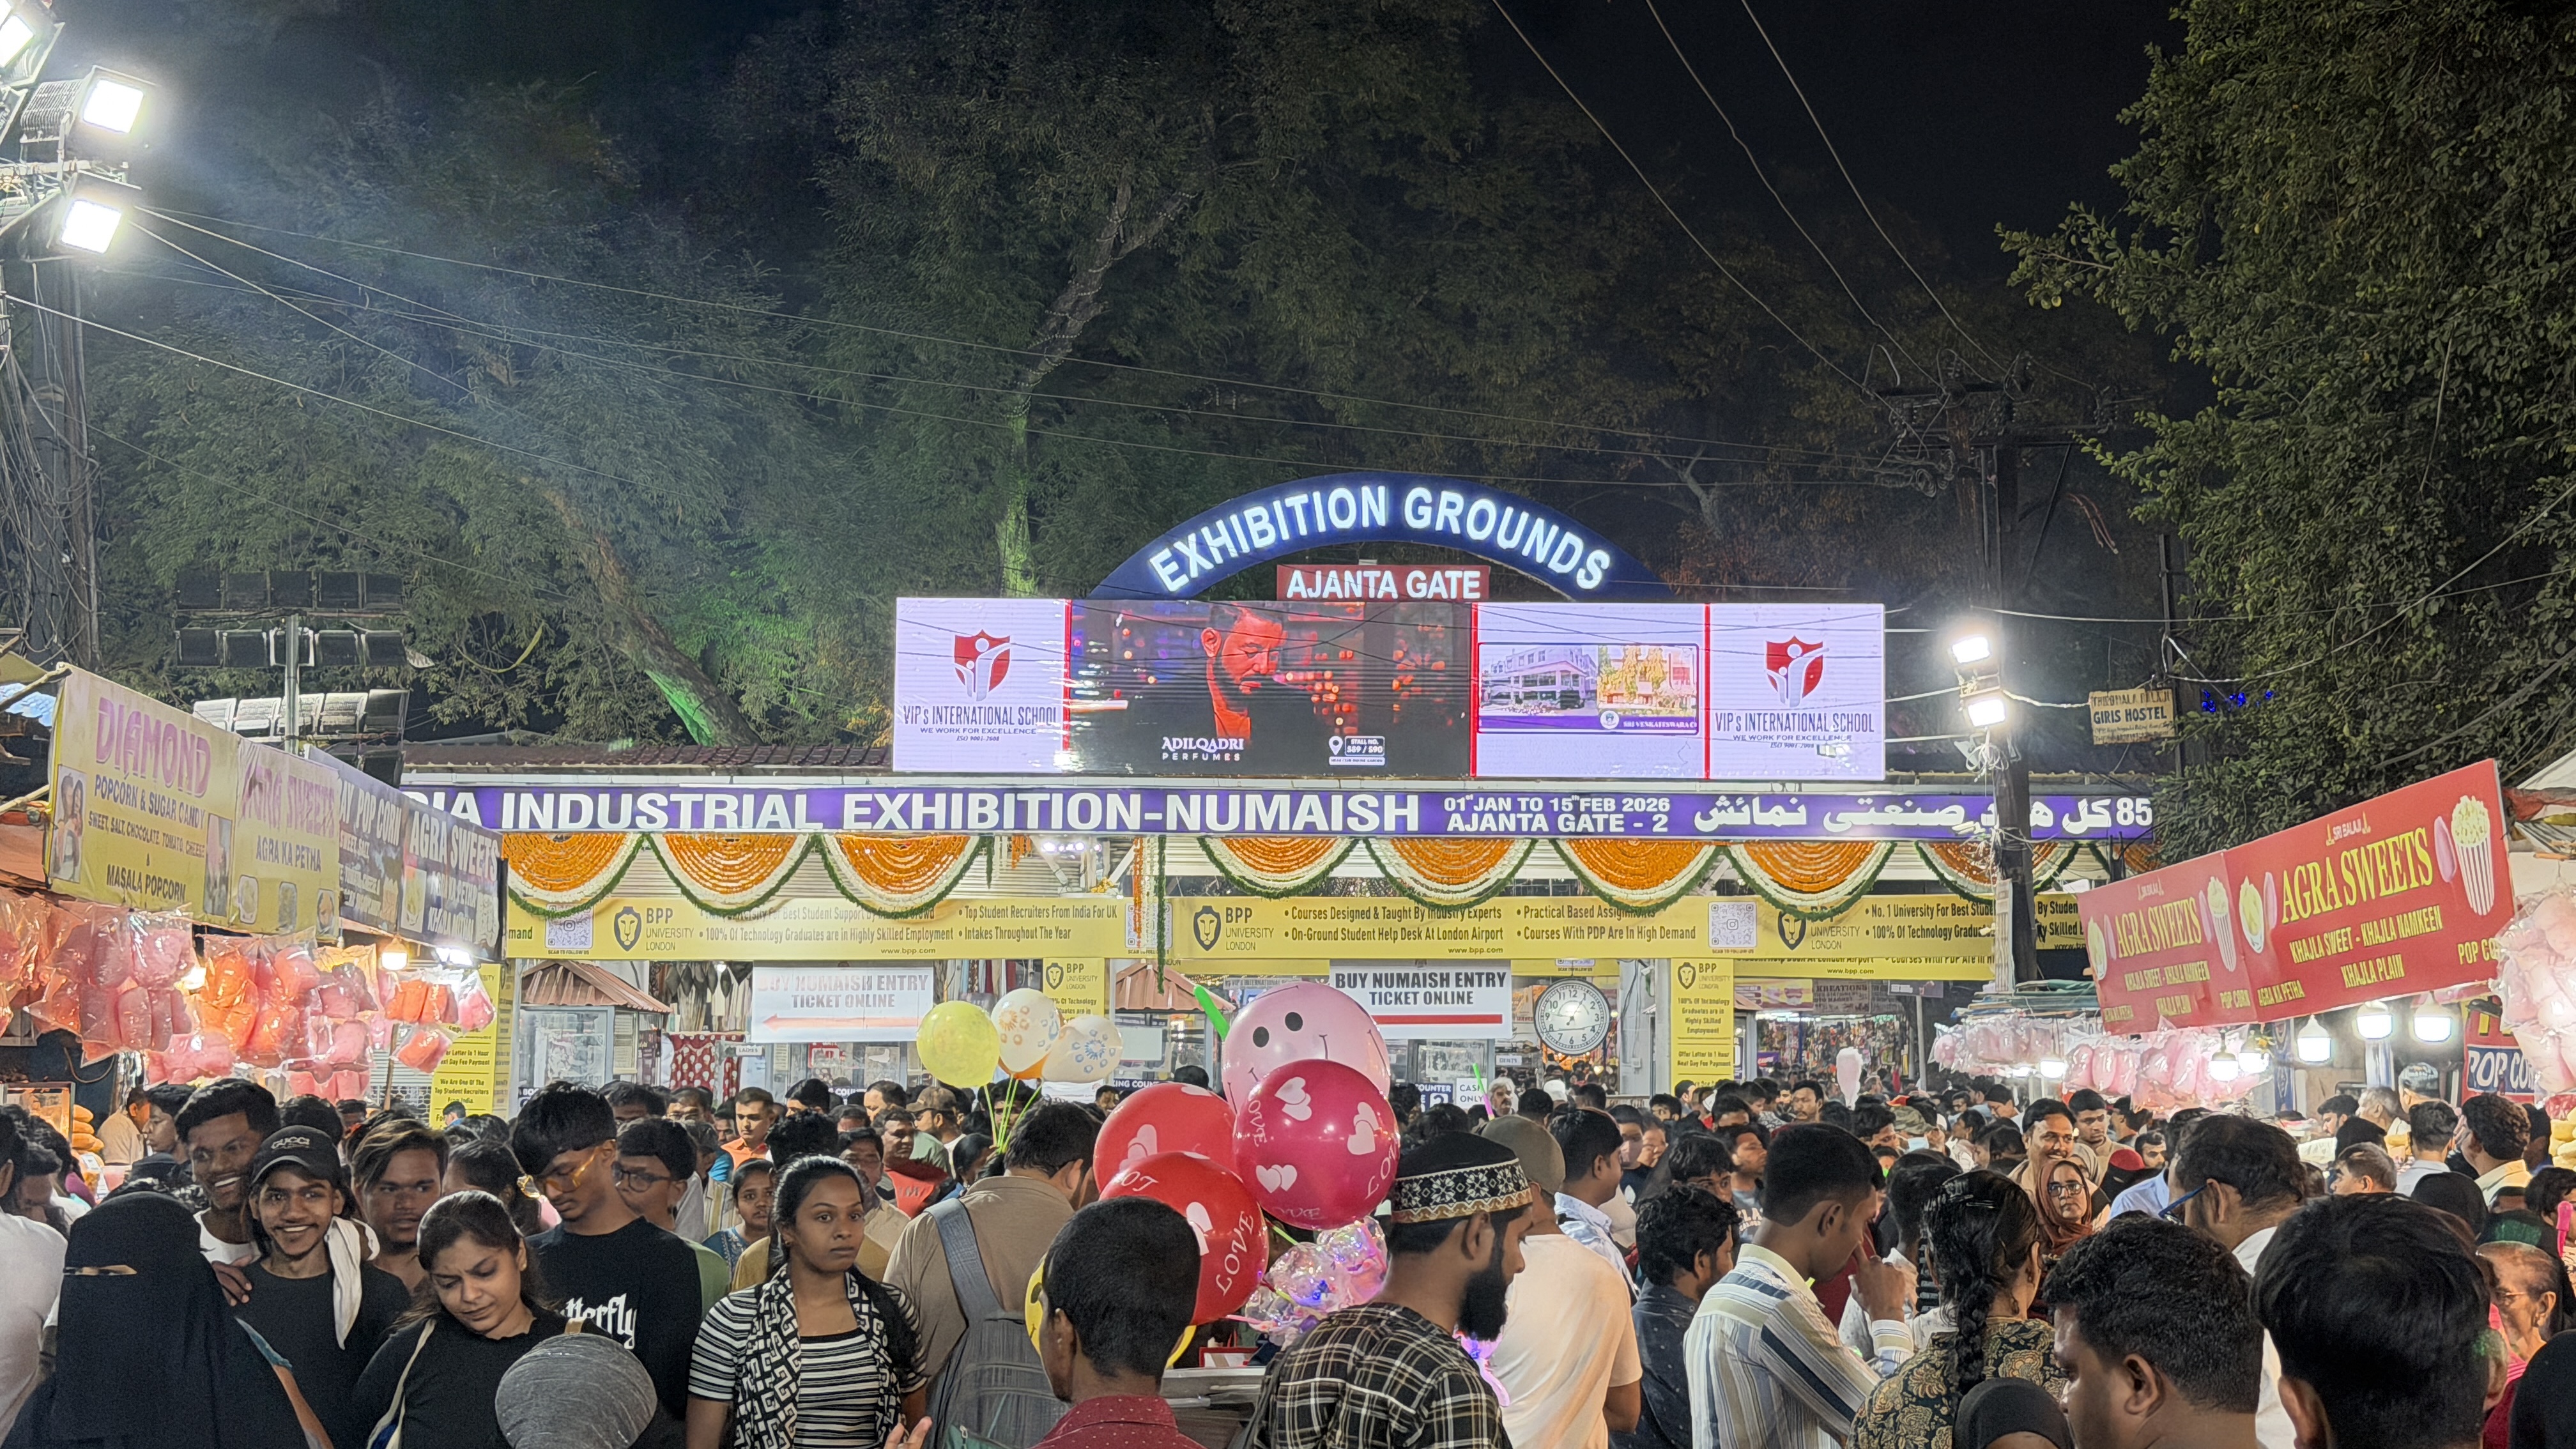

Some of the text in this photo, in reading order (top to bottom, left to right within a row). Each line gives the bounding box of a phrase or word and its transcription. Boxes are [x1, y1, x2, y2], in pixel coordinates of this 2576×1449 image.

[1149, 486, 1611, 592] EXHIBITION GROUNDS
[1286, 571, 1481, 599] AJANTA GATE
[1715, 712, 1874, 732] VIP's INTERNATIONAL SCHOOL
[2125, 706, 2167, 722] HOSTEL
[96, 696, 211, 798] DIAMOND
[1162, 737, 1244, 753] ADILQADRI
[1162, 753, 1240, 761] PERFUMES
[95, 774, 139, 809] POPCORN
[148, 792, 176, 822] SUGAR
[178, 802, 206, 830] CANDY
[1473, 797, 1512, 812] JAN
[1517, 797, 1544, 812] TO
[1580, 797, 1615, 812] FEB
[1622, 797, 1670, 812] 2026
[356, 788, 376, 835] POP
[376, 798, 402, 847] CORN
[501, 792, 823, 832] INDUSTRIAL
[843, 792, 1419, 832] EXHIBITION-NUMAISH
[1694, 797, 1806, 831] نمائش
[2062, 798, 2112, 833] کل
[2117, 798, 2152, 825] 85
[1447, 813, 1549, 832] AJANTA
[1558, 813, 1625, 832] GATE
[1652, 813, 1668, 832] 2
[256, 835, 321, 873] AGRA KA PETHA
[409, 810, 500, 882] AGRA SWEETS
[2281, 826, 2434, 924] AGRA SWEETS
[106, 864, 186, 903] MASALA POPCORN
[646, 907, 673, 924] BPP
[965, 905, 1117, 922] Top Student Recruiters From India For UK
[1225, 907, 1253, 924] BPP
[1291, 906, 1329, 920] Courses
[1330, 906, 1372, 923] Designed
[1373, 906, 1379, 920] &
[1382, 906, 1412, 923] Taught
[1414, 906, 1425, 923] By
[1469, 906, 1502, 923] Experts
[1524, 905, 1595, 919] Practical Based
[646, 928, 694, 939] UNIVERSITY
[965, 927, 1071, 943] Intakes Throughout The Year
[1225, 928, 1275, 939] UNIVERSITY
[1524, 926, 1696, 942] Courses With PDP Are In High Demand
[1811, 926, 1860, 937] UNIVERSITY
[1872, 925, 1952, 941] 100% Of Technology
[2050, 921, 2078, 936] Skilled
[2115, 896, 2202, 958] AGRA SWEETS
[2289, 935, 2325, 965] KHAJLA
[2326, 926, 2354, 955] SWEET
[2361, 917, 2397, 947] KHAJLA
[2397, 905, 2444, 940] NAMKEEN
[705, 927, 954, 944] 100% Of Technology Graduates are in Highly Skilled Employment
[1291, 927, 1503, 944] On-Ground Student Help Desk At London Airport
[646, 942, 676, 951] LONDON
[880, 947, 936, 955] www.bpp.com
[1225, 942, 1256, 951] LONDON
[1811, 940, 1842, 950] LONDON
[2457, 941, 2478, 965] POP
[1066, 963, 1085, 974] BPP
[1699, 963, 1717, 973] BPP
[2340, 954, 2405, 989] KHAJLA PLAIN
[756, 975, 929, 991] BUY NUMAISH ENTRY
[1335, 972, 1506, 988] BUY NUMAISH ENTRY
[791, 994, 895, 1008] TICKET ONLINE
[1368, 990, 1474, 1005] TICKET ONLINE
[1568, 990, 1578, 998] 12
[1595, 1013, 1600, 1022] 3
[1569, 1036, 1574, 1045] 6
[271, 1137, 310, 1149] GUCCI
[1216, 1211, 1255, 1297] LOVE
